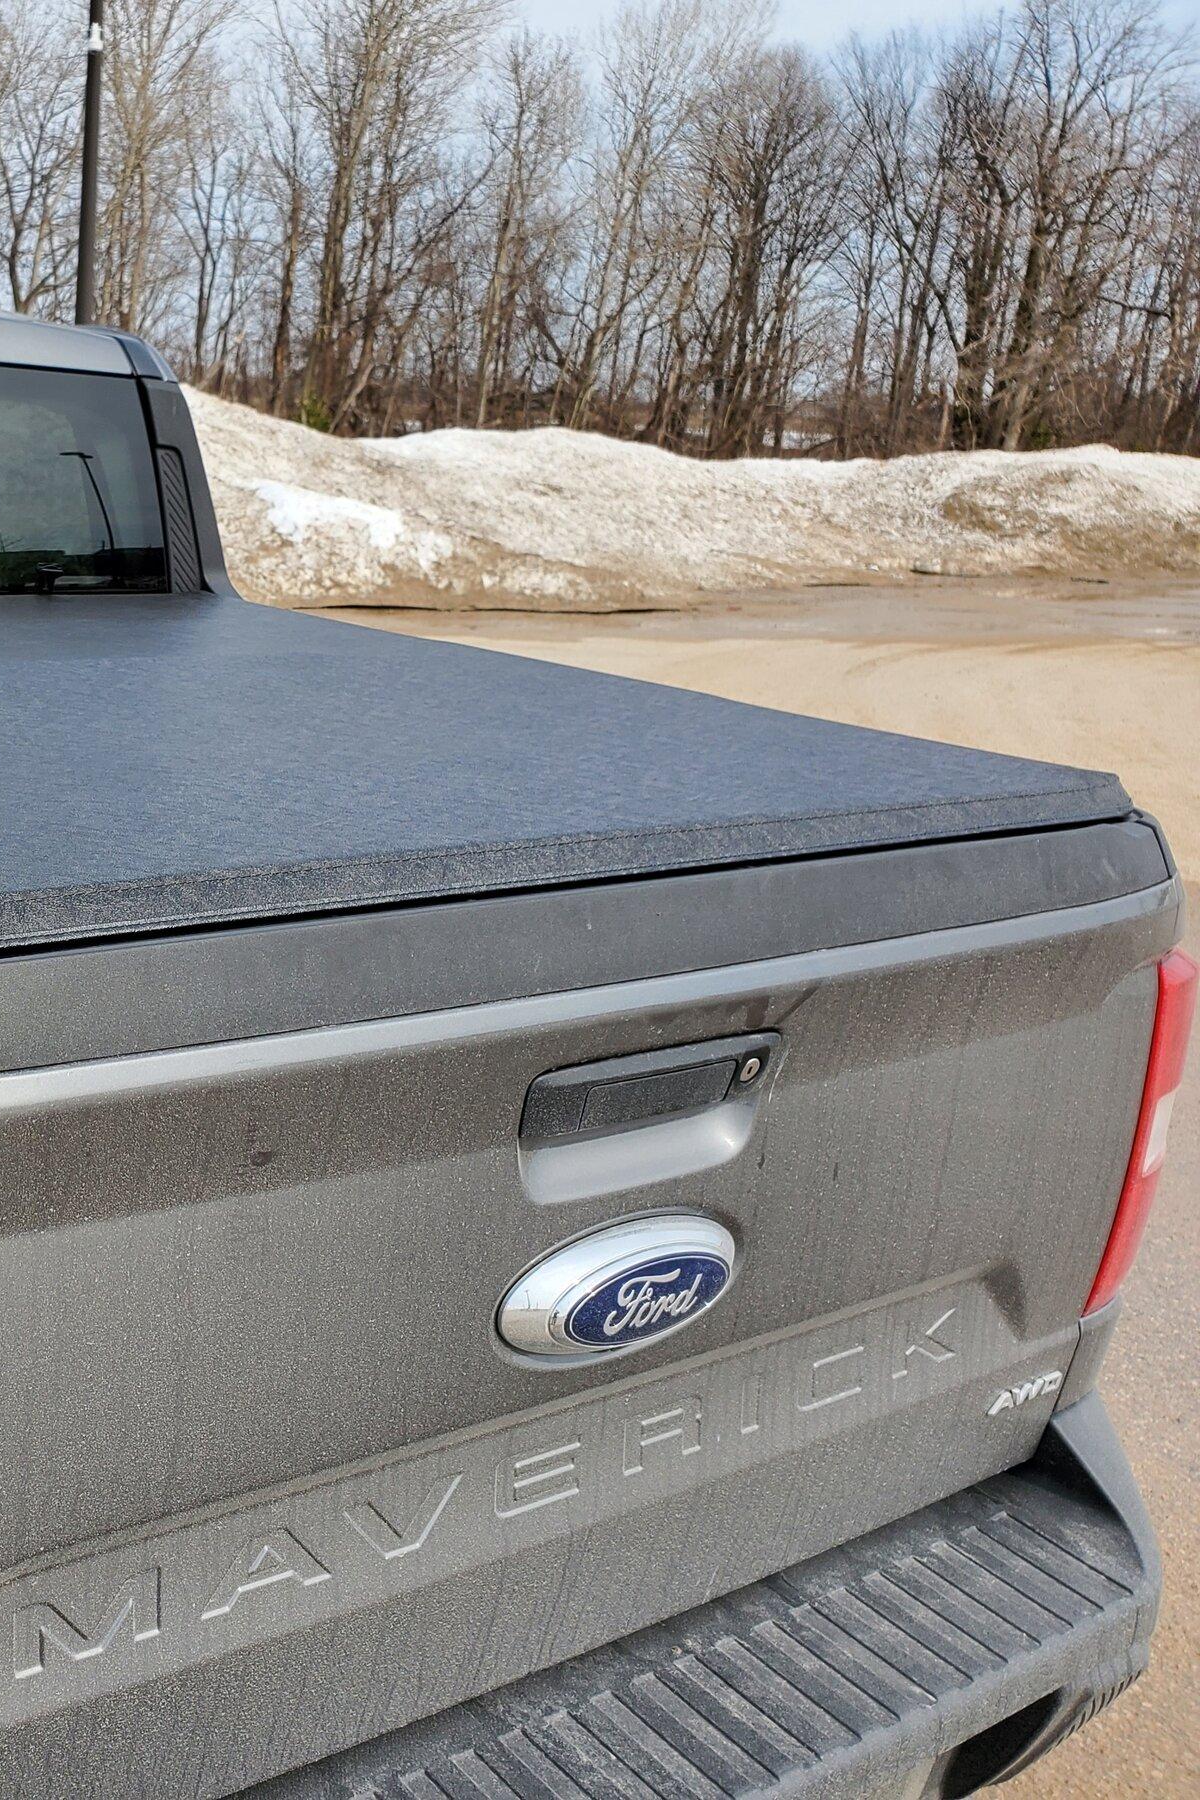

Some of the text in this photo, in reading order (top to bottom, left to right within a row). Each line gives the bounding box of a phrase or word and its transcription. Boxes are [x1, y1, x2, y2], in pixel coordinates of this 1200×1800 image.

[602, 1267, 703, 1337] Ford
[986, 1370, 1064, 1416] AWD
[12, 1306, 957, 1681] MAVERICK
